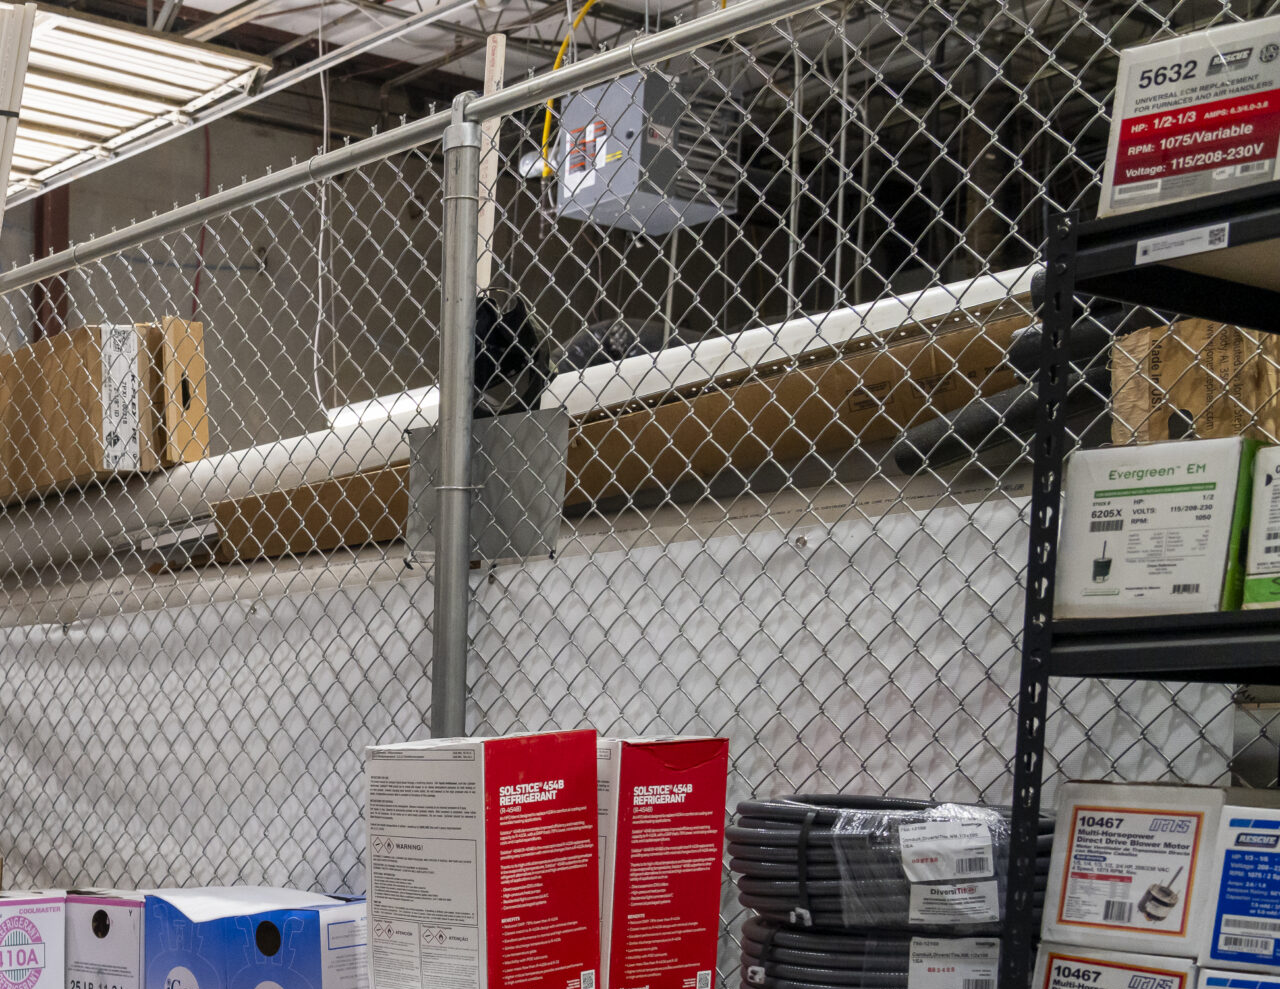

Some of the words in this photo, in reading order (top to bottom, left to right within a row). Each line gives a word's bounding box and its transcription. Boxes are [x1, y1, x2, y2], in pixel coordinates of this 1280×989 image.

[1212, 50, 1252, 66] RESCUE
[1138, 60, 1198, 89] 5632
[1134, 103, 1150, 113] FOR
[1152, 96, 1192, 112] FURNACES
[1194, 91, 1212, 102] AND
[1213, 88, 1227, 98] AIR
[1229, 79, 1273, 96] HANDLERS
[1135, 90, 1178, 105] UNIVERSAL
[1199, 74, 1259, 92] REPLACEMENT
[1130, 123, 1149, 134] HP:
[1153, 111, 1196, 130] 1/2-1/3
[1204, 109, 1228, 120] AMPS:
[1127, 143, 1155, 156] RPM:
[1159, 122, 1254, 150] 1075/Variable
[1125, 163, 1166, 178] Voltage:
[1170, 142, 1264, 171] 115/208-230V
[1187, 464, 1207, 474] EM
[1091, 509, 1122, 519] 6205X
[1171, 504, 1213, 512] 115/208-230
[543, 780, 564, 790] 454B
[673, 783, 693, 794] 454B
[500, 790, 557, 806] REFRIGERANT
[633, 793, 686, 805] REFRIGERANT
[1079, 816, 1124, 829] 10467
[1078, 829, 1155, 840] Multi-Horsepower
[1238, 834, 1277, 844] RESCUE
[395, 842, 424, 852] WARNING!
[1077, 836, 1103, 844] Direct
[1130, 840, 1160, 848] Blower
[1163, 842, 1190, 850] Motor
[19, 906, 60, 915] COOLMASTER
[1054, 965, 1101, 983] 10467
